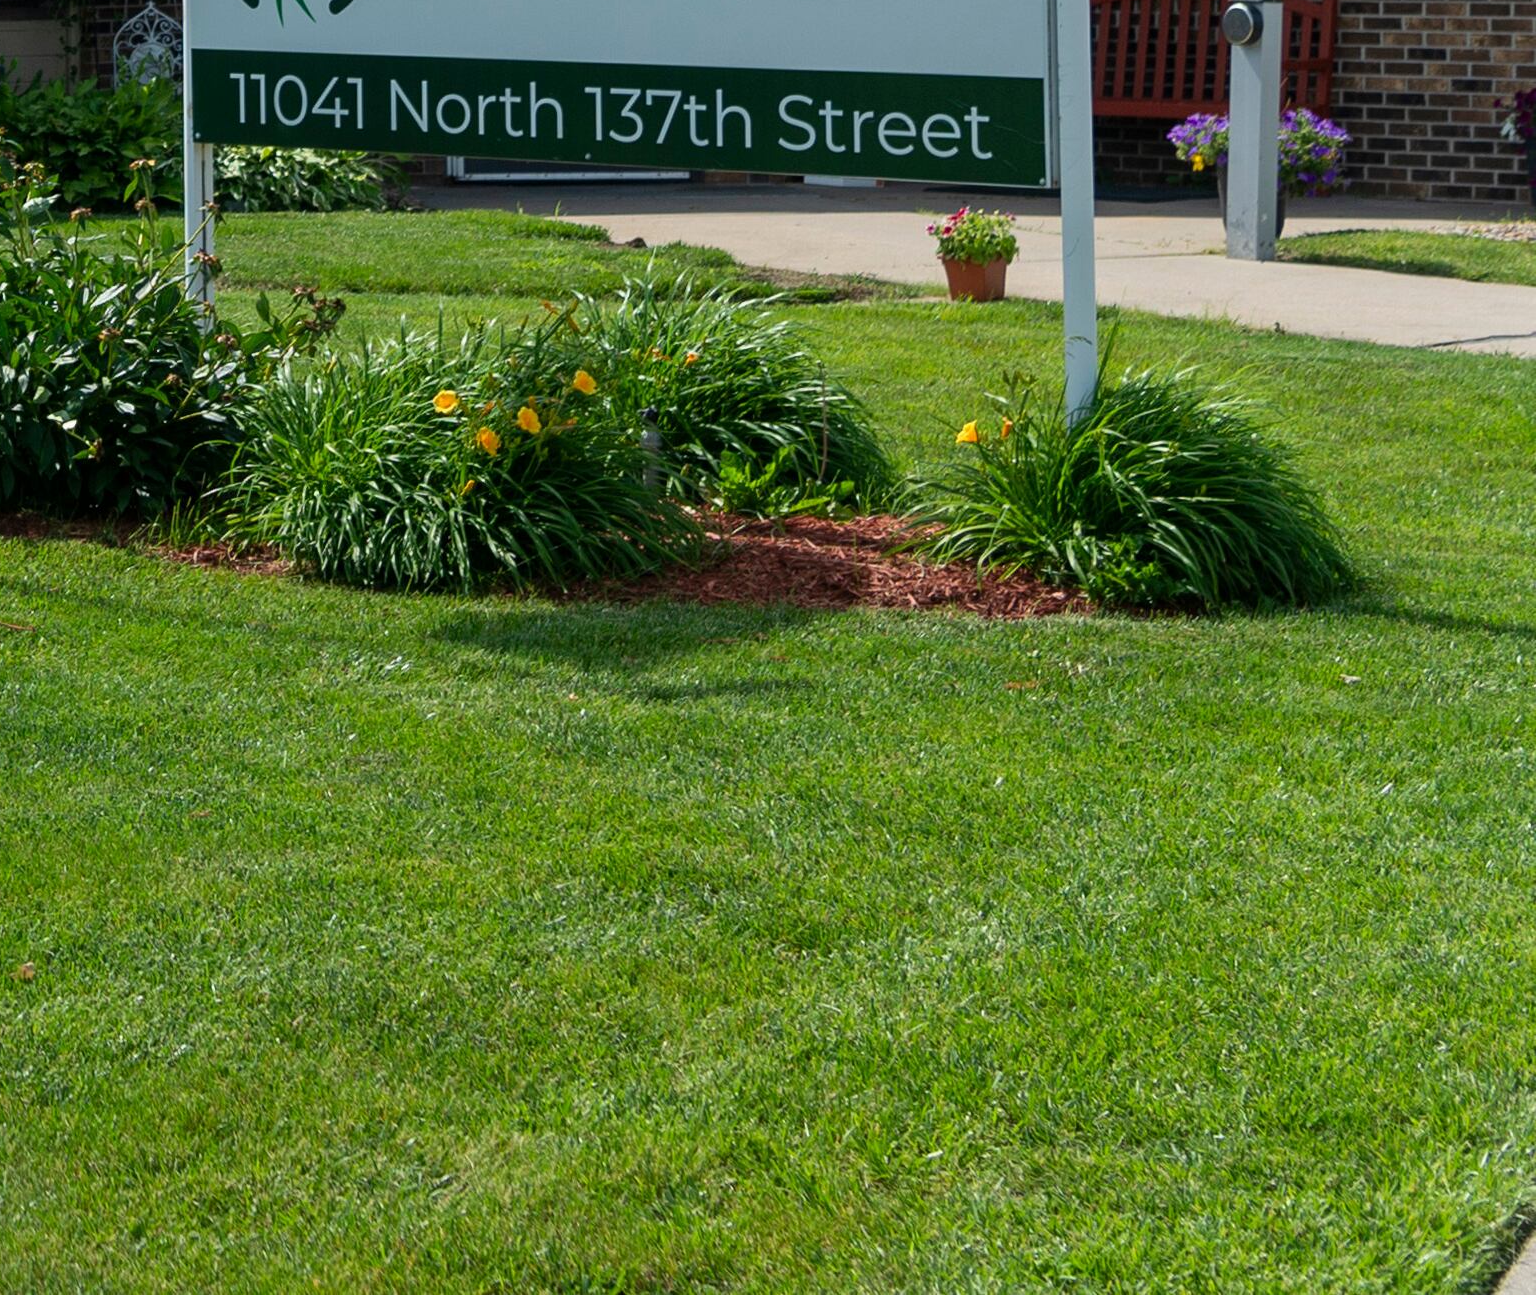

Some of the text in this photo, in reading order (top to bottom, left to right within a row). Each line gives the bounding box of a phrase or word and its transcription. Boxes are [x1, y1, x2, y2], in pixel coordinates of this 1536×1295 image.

[229, 73, 993, 159] 11041 North 137th Street
